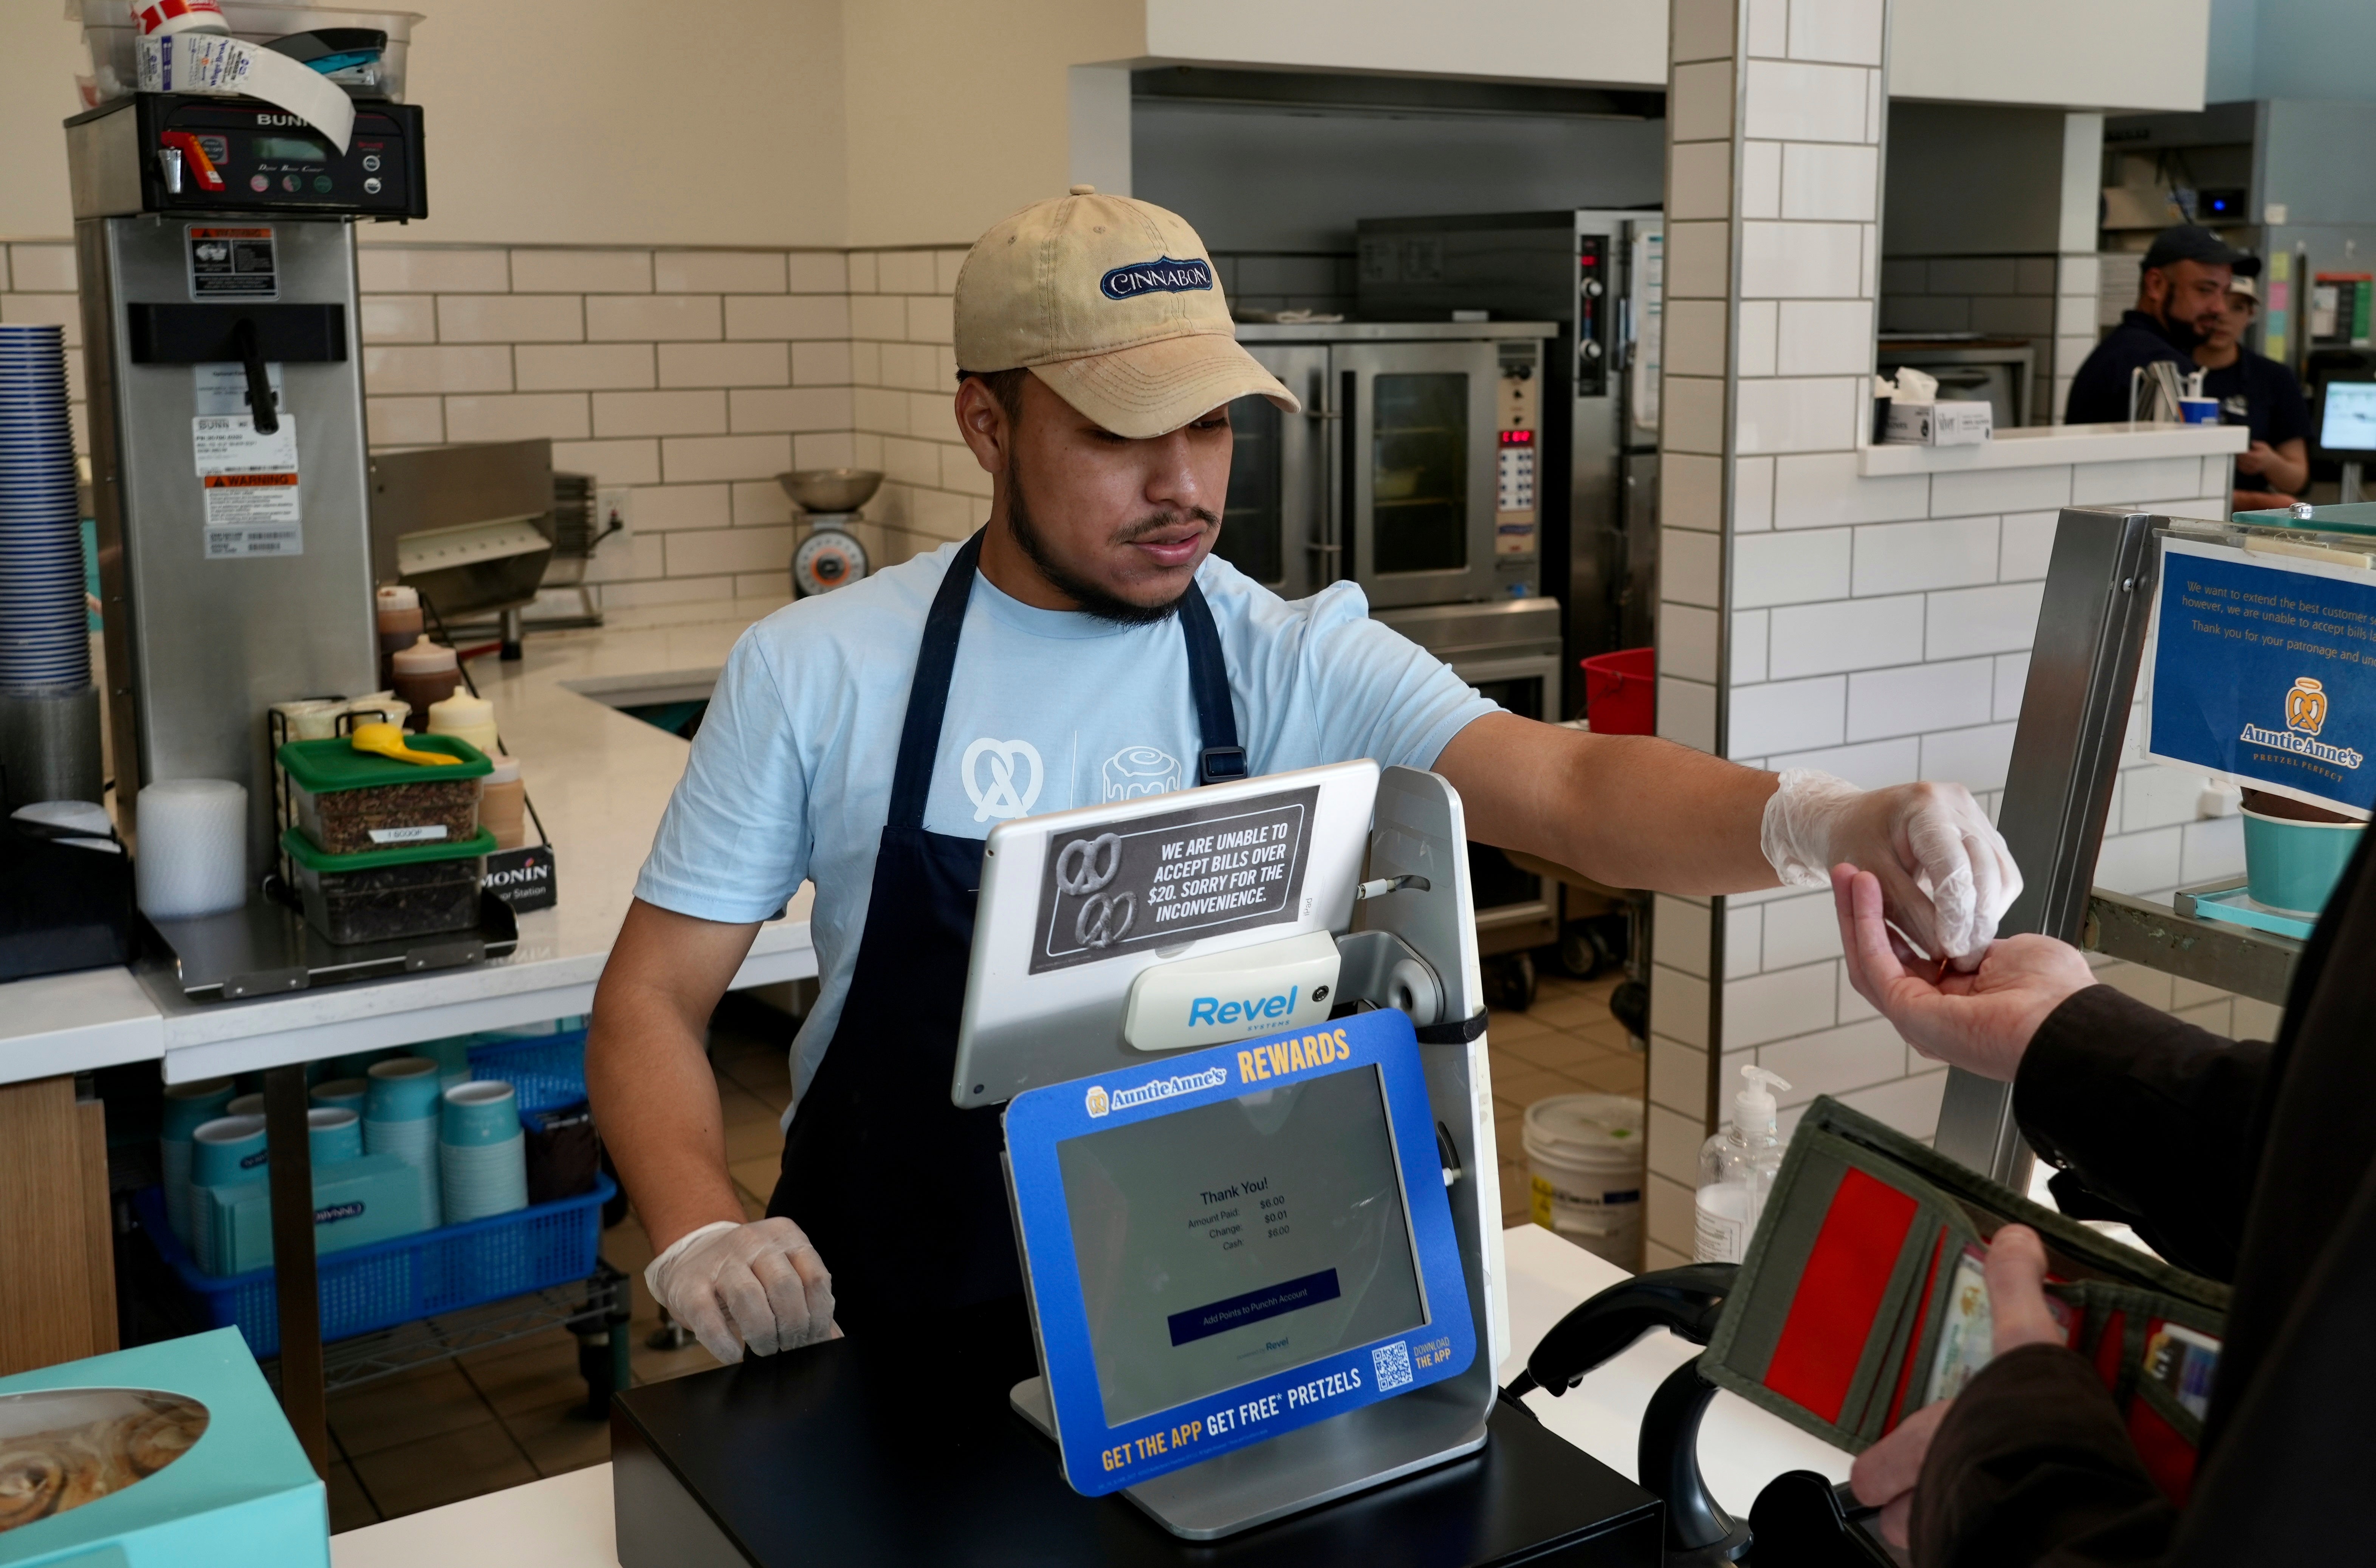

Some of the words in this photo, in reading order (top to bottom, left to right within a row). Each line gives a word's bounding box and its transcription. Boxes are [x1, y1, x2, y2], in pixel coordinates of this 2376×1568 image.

[1111, 267, 1209, 294] CINNABON
[229, 474, 290, 486] WARNING
[2187, 581, 2201, 593] We
[2204, 587, 2227, 598] want
[2231, 590, 2240, 600] to
[2243, 595, 2277, 606] extend
[2280, 597, 2296, 610] the
[2299, 600, 2319, 614] best
[2322, 607, 2367, 623] customer
[2182, 595, 2223, 614] however,
[2227, 606, 2241, 615] we
[2243, 608, 2259, 619] are
[2262, 612, 2296, 625] unable
[2299, 618, 2309, 628] to
[2312, 621, 2345, 636] accept
[2347, 625, 2367, 640] bills
[2192, 620, 2221, 635] Thank
[2224, 628, 2241, 639] you
[2245, 629, 2259, 641] for
[2262, 635, 2284, 646] your
[2287, 640, 2337, 659] patronage
[2340, 650, 2359, 662] and
[2253, 753, 2298, 767] PRETZEL
[2302, 761, 2343, 782] PERFECT
[1162, 841, 1184, 861] WE
[1185, 836, 1214, 856] ARE
[1216, 826, 1269, 850] UNABLE
[1272, 823, 1288, 840] TO
[480, 864, 548, 888] MONIN
[1154, 857, 1210, 883] ACCEPT
[1211, 850, 1249, 872] BILLS
[1252, 843, 1286, 865] OVER
[513, 886, 547, 900] Station
[1148, 885, 1177, 906] $20.
[1180, 874, 1229, 898] SORRY
[1229, 869, 1257, 889] FOR
[1260, 863, 1285, 882] THE
[1156, 886, 1267, 922] INCONVENIENCE.
[1304, 897, 1313, 916] iPad
[1188, 985, 1298, 1027] Revel
[1247, 1020, 1290, 1032] SYSTEMS
[1237, 1028, 1350, 1084] REWARDS
[1200, 1185, 1240, 1206] Thank
[1241, 1176, 1269, 1194] You!
[1188, 1213, 1219, 1229] Amount
[1220, 1208, 1240, 1220] Paid:
[1260, 1195, 1285, 1210] $6.00
[1209, 1224, 1242, 1239] Change:
[1264, 1210, 1287, 1224] $0.01
[1223, 1239, 1244, 1251] Cash:
[1268, 1225, 1290, 1239] $6.00
[1203, 1314, 1218, 1326] Add
[1219, 1309, 1241, 1321] Points
[1251, 1297, 1278, 1311] Punchh
[1279, 1289, 1307, 1302] Account
[1265, 1337, 1289, 1351] Revel
[1413, 1336, 1450, 1357] DOWNLOAD
[1415, 1354, 1433, 1370] THE
[1434, 1347, 1451, 1363] APP
[1103, 1443, 1131, 1471] GET
[1136, 1433, 1167, 1459] THE
[1172, 1421, 1201, 1448] APP
[1207, 1409, 1234, 1435] GET
[1288, 1368, 1361, 1408] PRETZELS
